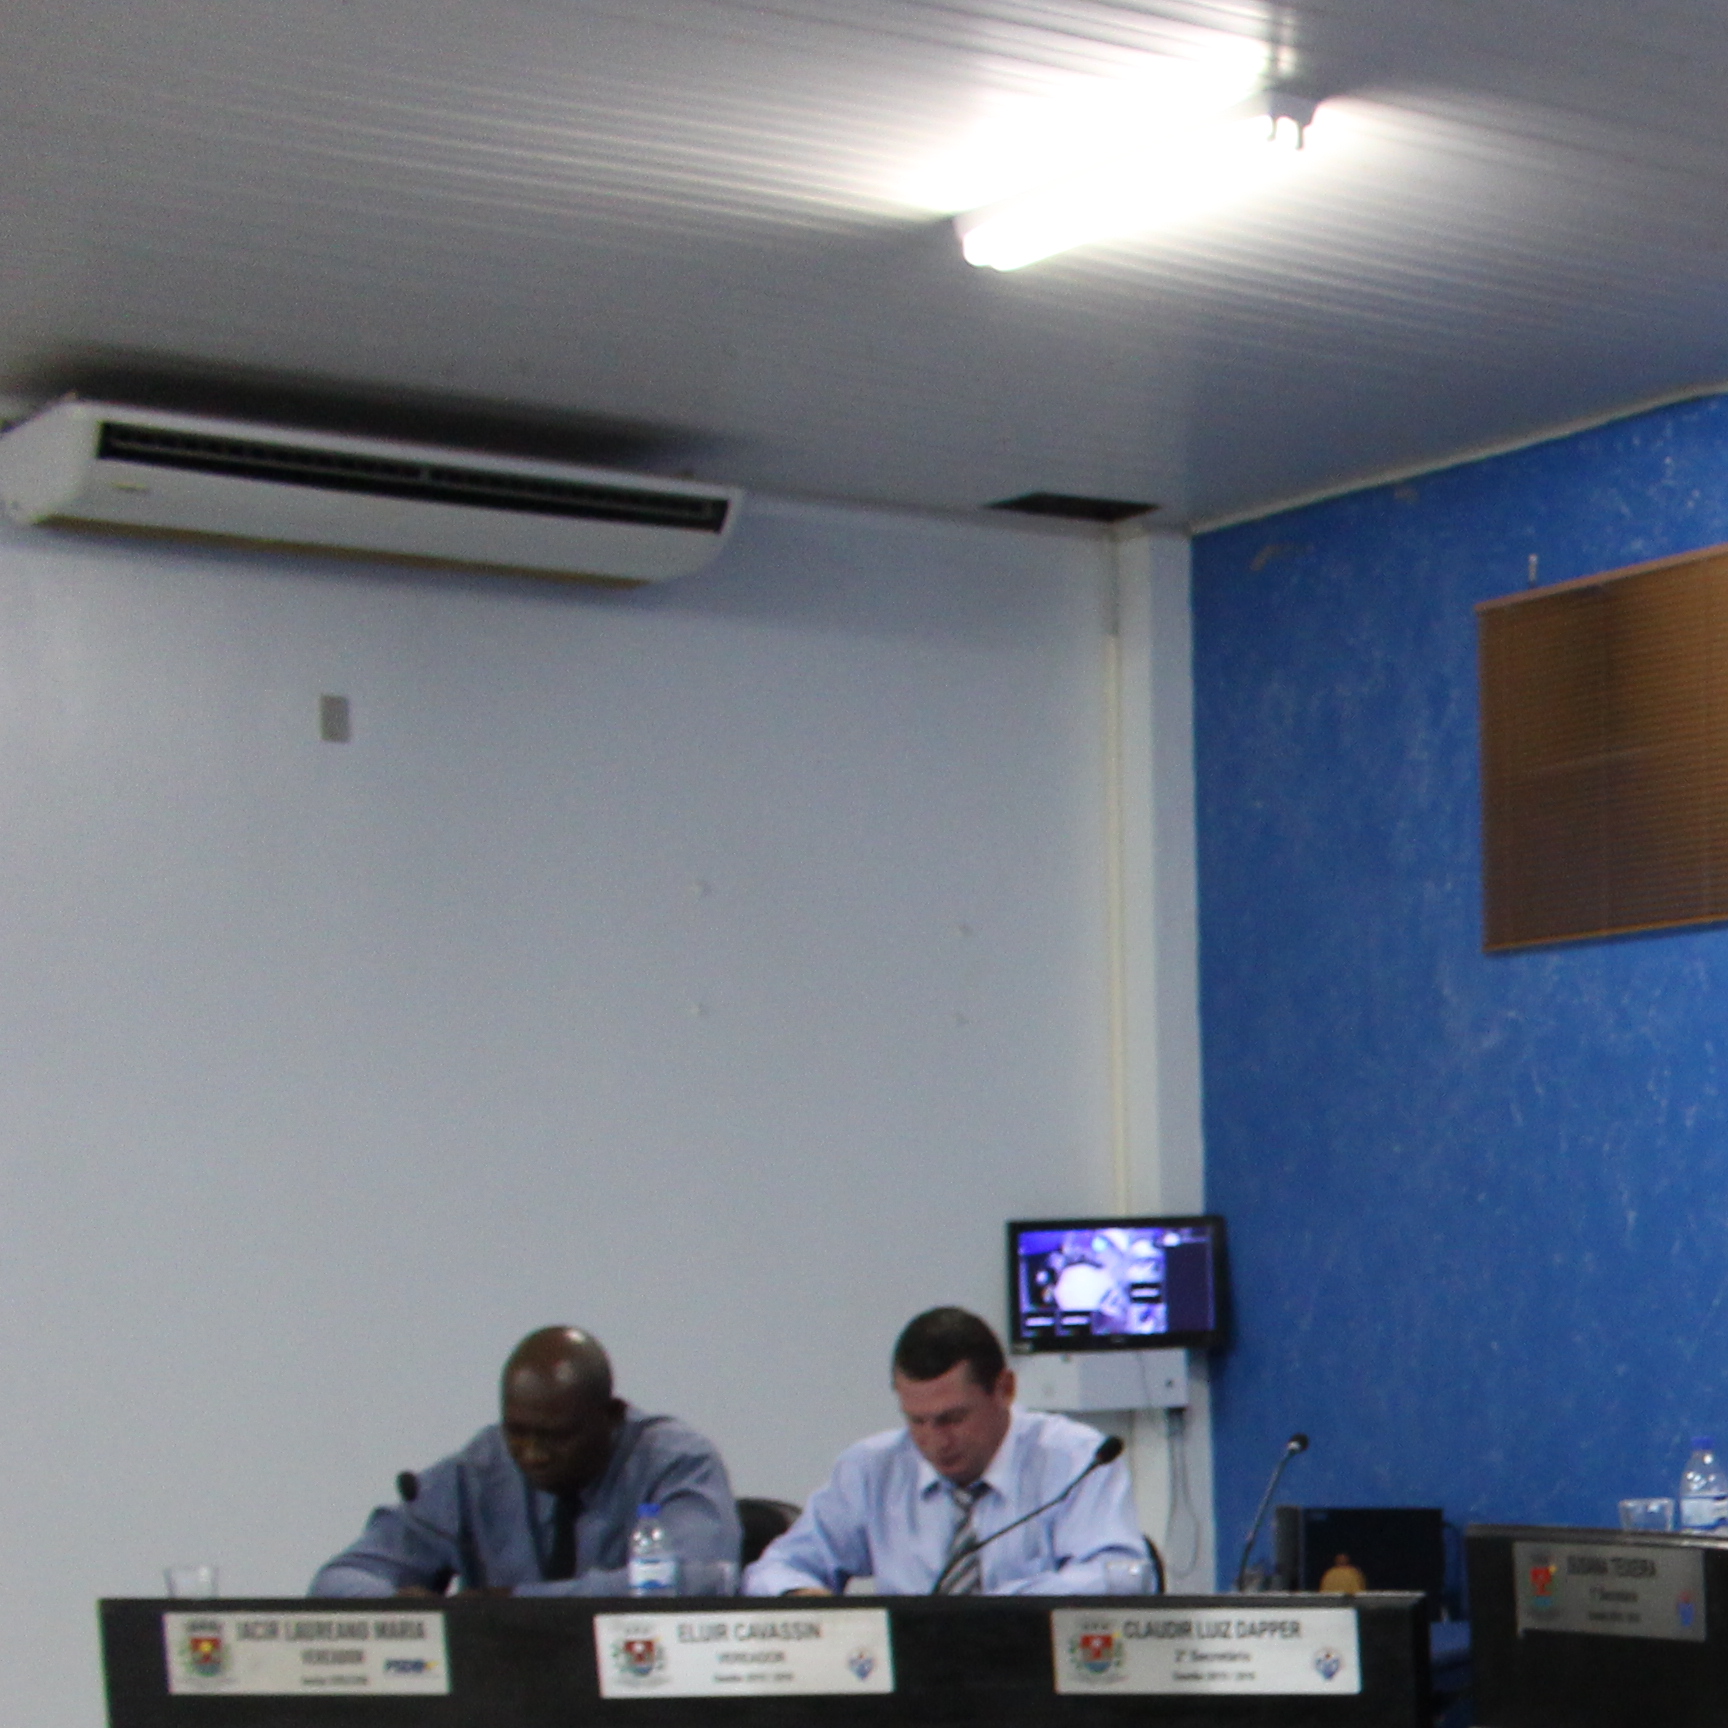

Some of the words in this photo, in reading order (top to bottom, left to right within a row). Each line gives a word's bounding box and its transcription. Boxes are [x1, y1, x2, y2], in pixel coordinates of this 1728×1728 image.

[373, 1620, 425, 1640] MARIA
[734, 1621, 823, 1641] CAVASSIN
[1122, 1620, 1193, 1640] CLAUDIR
[1200, 1620, 1232, 1640] LUIZ
[1237, 1619, 1302, 1639] DAPPER
